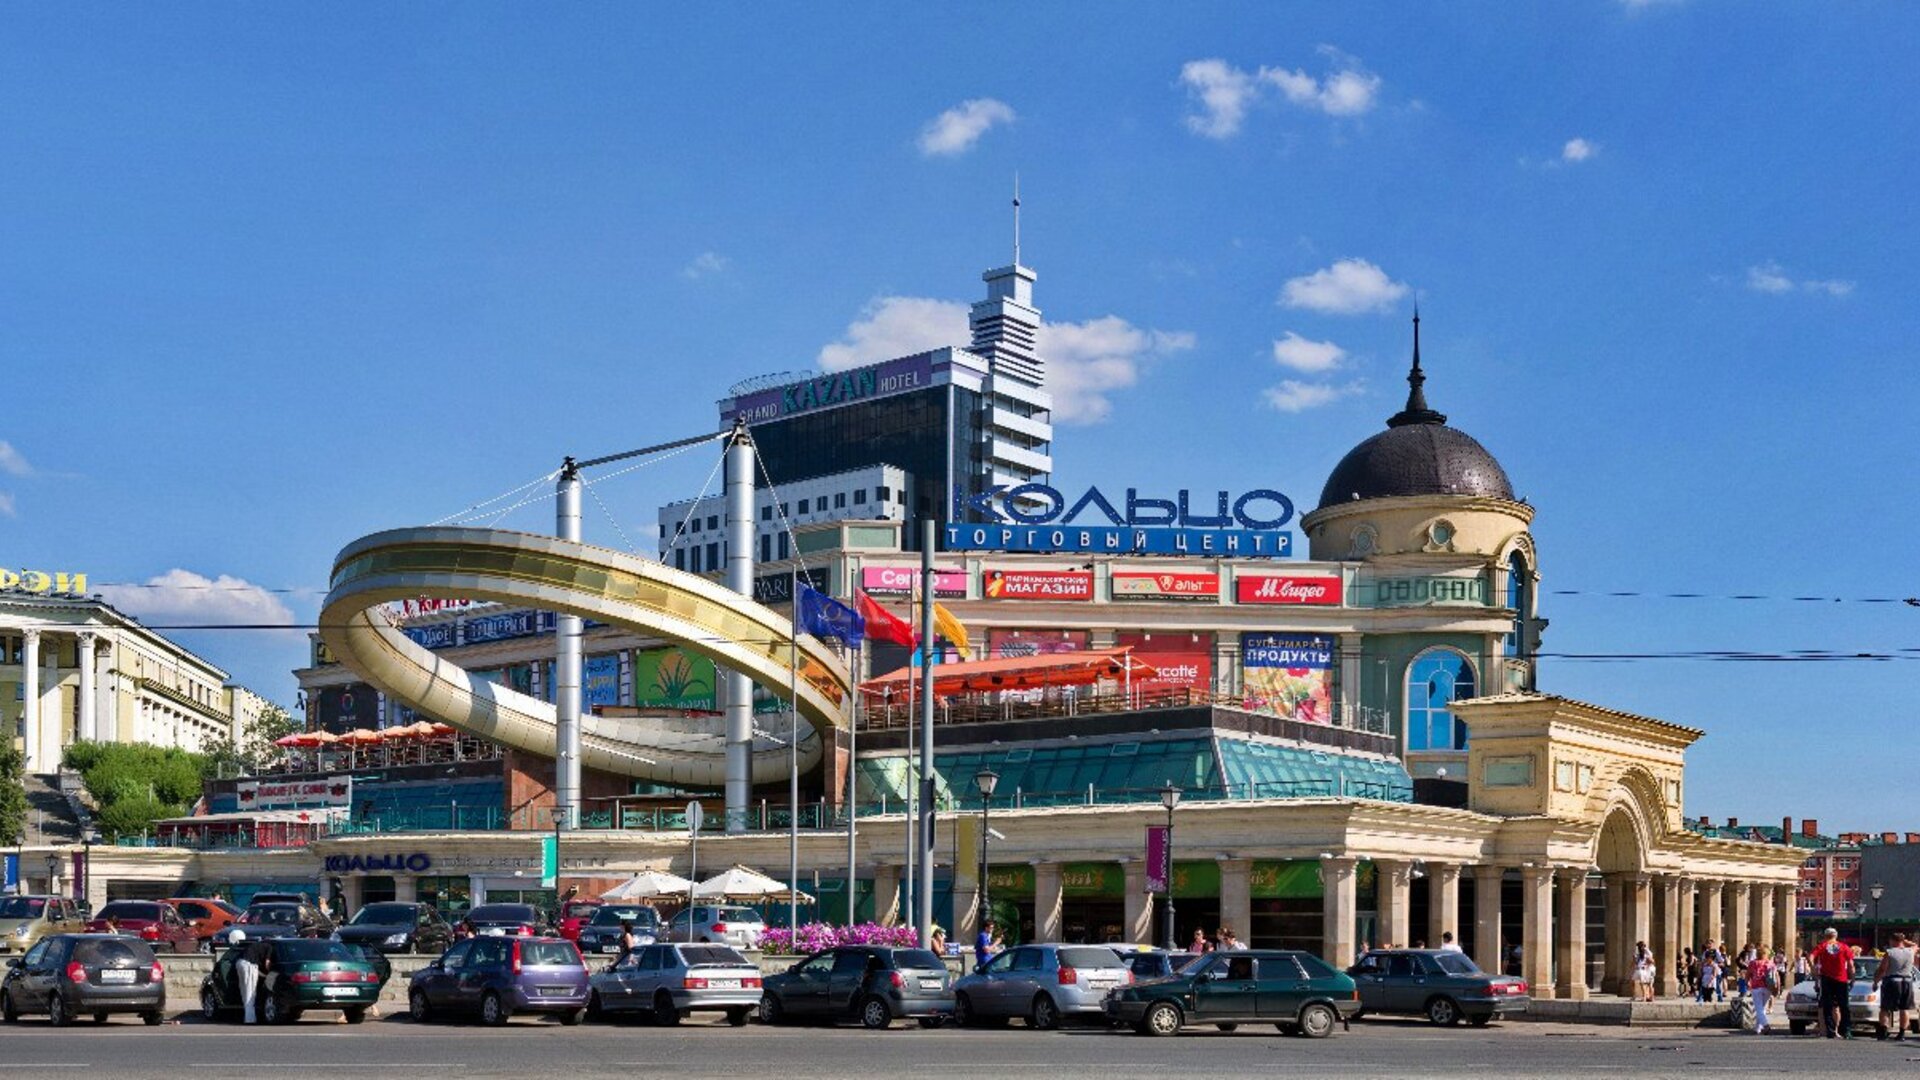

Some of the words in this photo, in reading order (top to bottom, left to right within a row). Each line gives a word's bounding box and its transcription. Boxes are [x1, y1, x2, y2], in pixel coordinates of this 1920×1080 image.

[739, 403, 778, 423] GRAND
[782, 367, 877, 415] KAZAN
[881, 371, 920, 393] HOTEL
[952, 482, 1294, 531] КОЛЬЦО
[948, 528, 1147, 549] ТОРГОВЫЙ
[1176, 533, 1289, 551] ЦЕНТР
[1005, 583, 1087, 594] МАГАЗИН
[1247, 639, 1331, 650] СУПЕРМАРКЕТ
[1246, 649, 1331, 663] ПРОДУКТЫ
[324, 853, 431, 872] КОЛЬЦО
